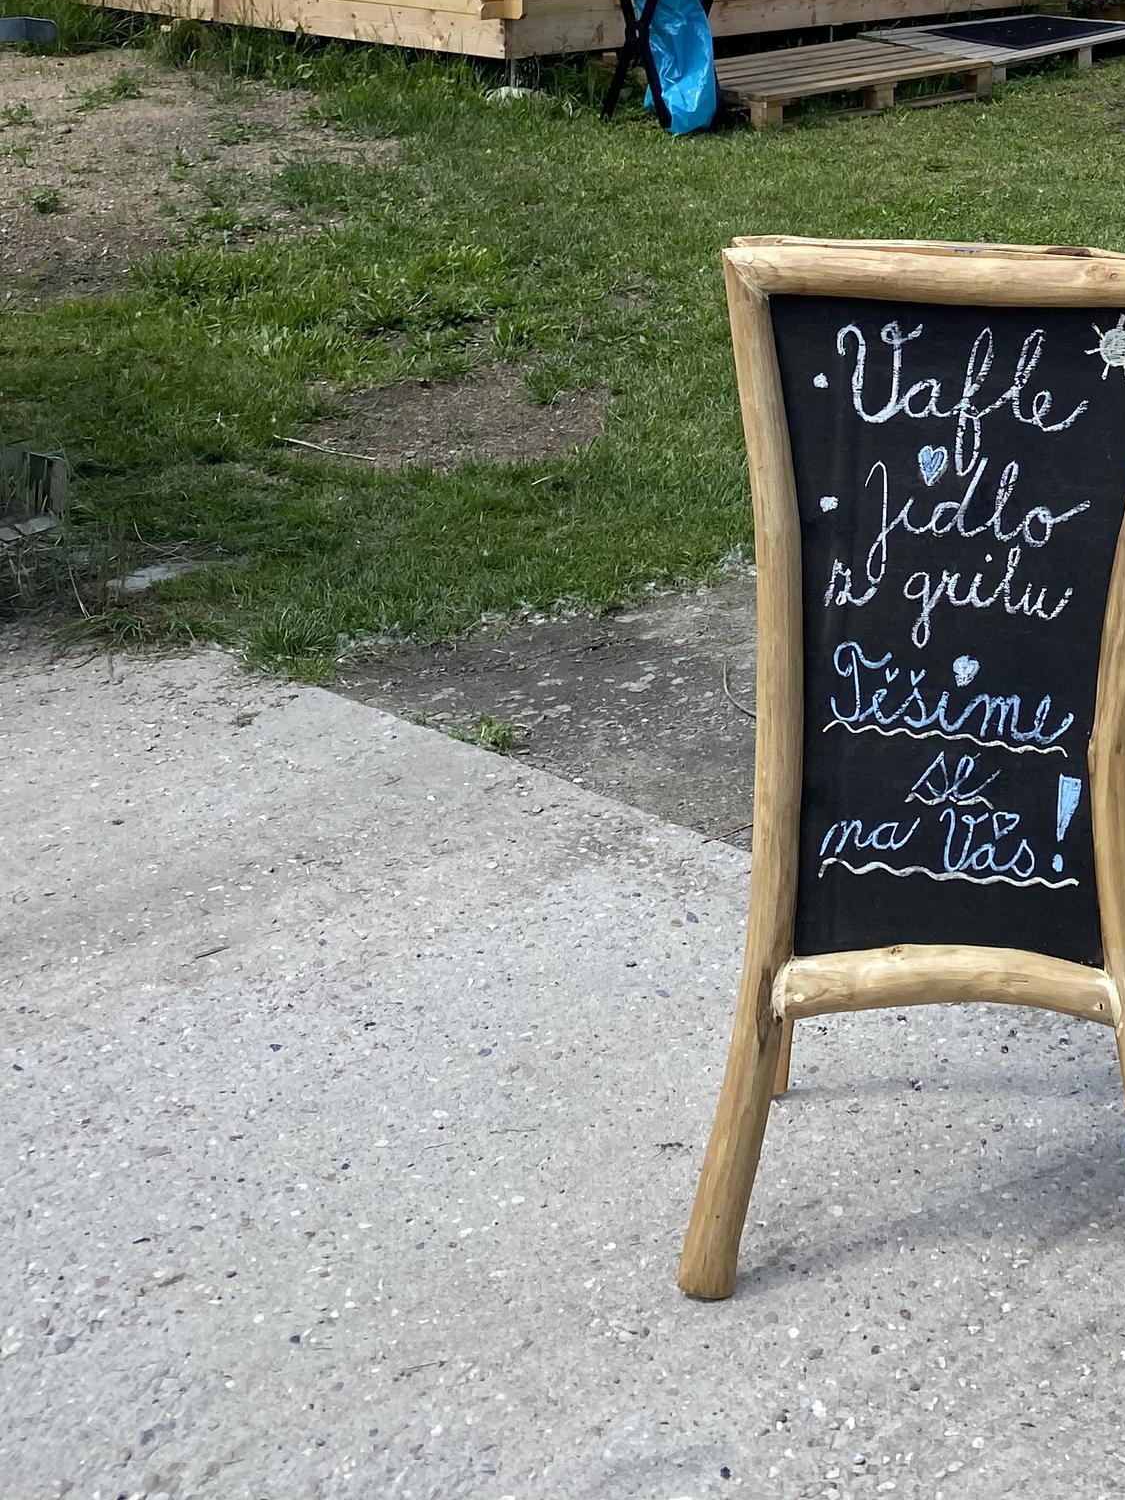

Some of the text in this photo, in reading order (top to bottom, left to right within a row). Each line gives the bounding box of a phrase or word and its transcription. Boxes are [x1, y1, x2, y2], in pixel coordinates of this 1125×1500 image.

[836, 320, 1089, 476] Vafle
[903, 543, 1075, 649] grilu
[910, 751, 1001, 801] se
[818, 816, 921, 857] na
